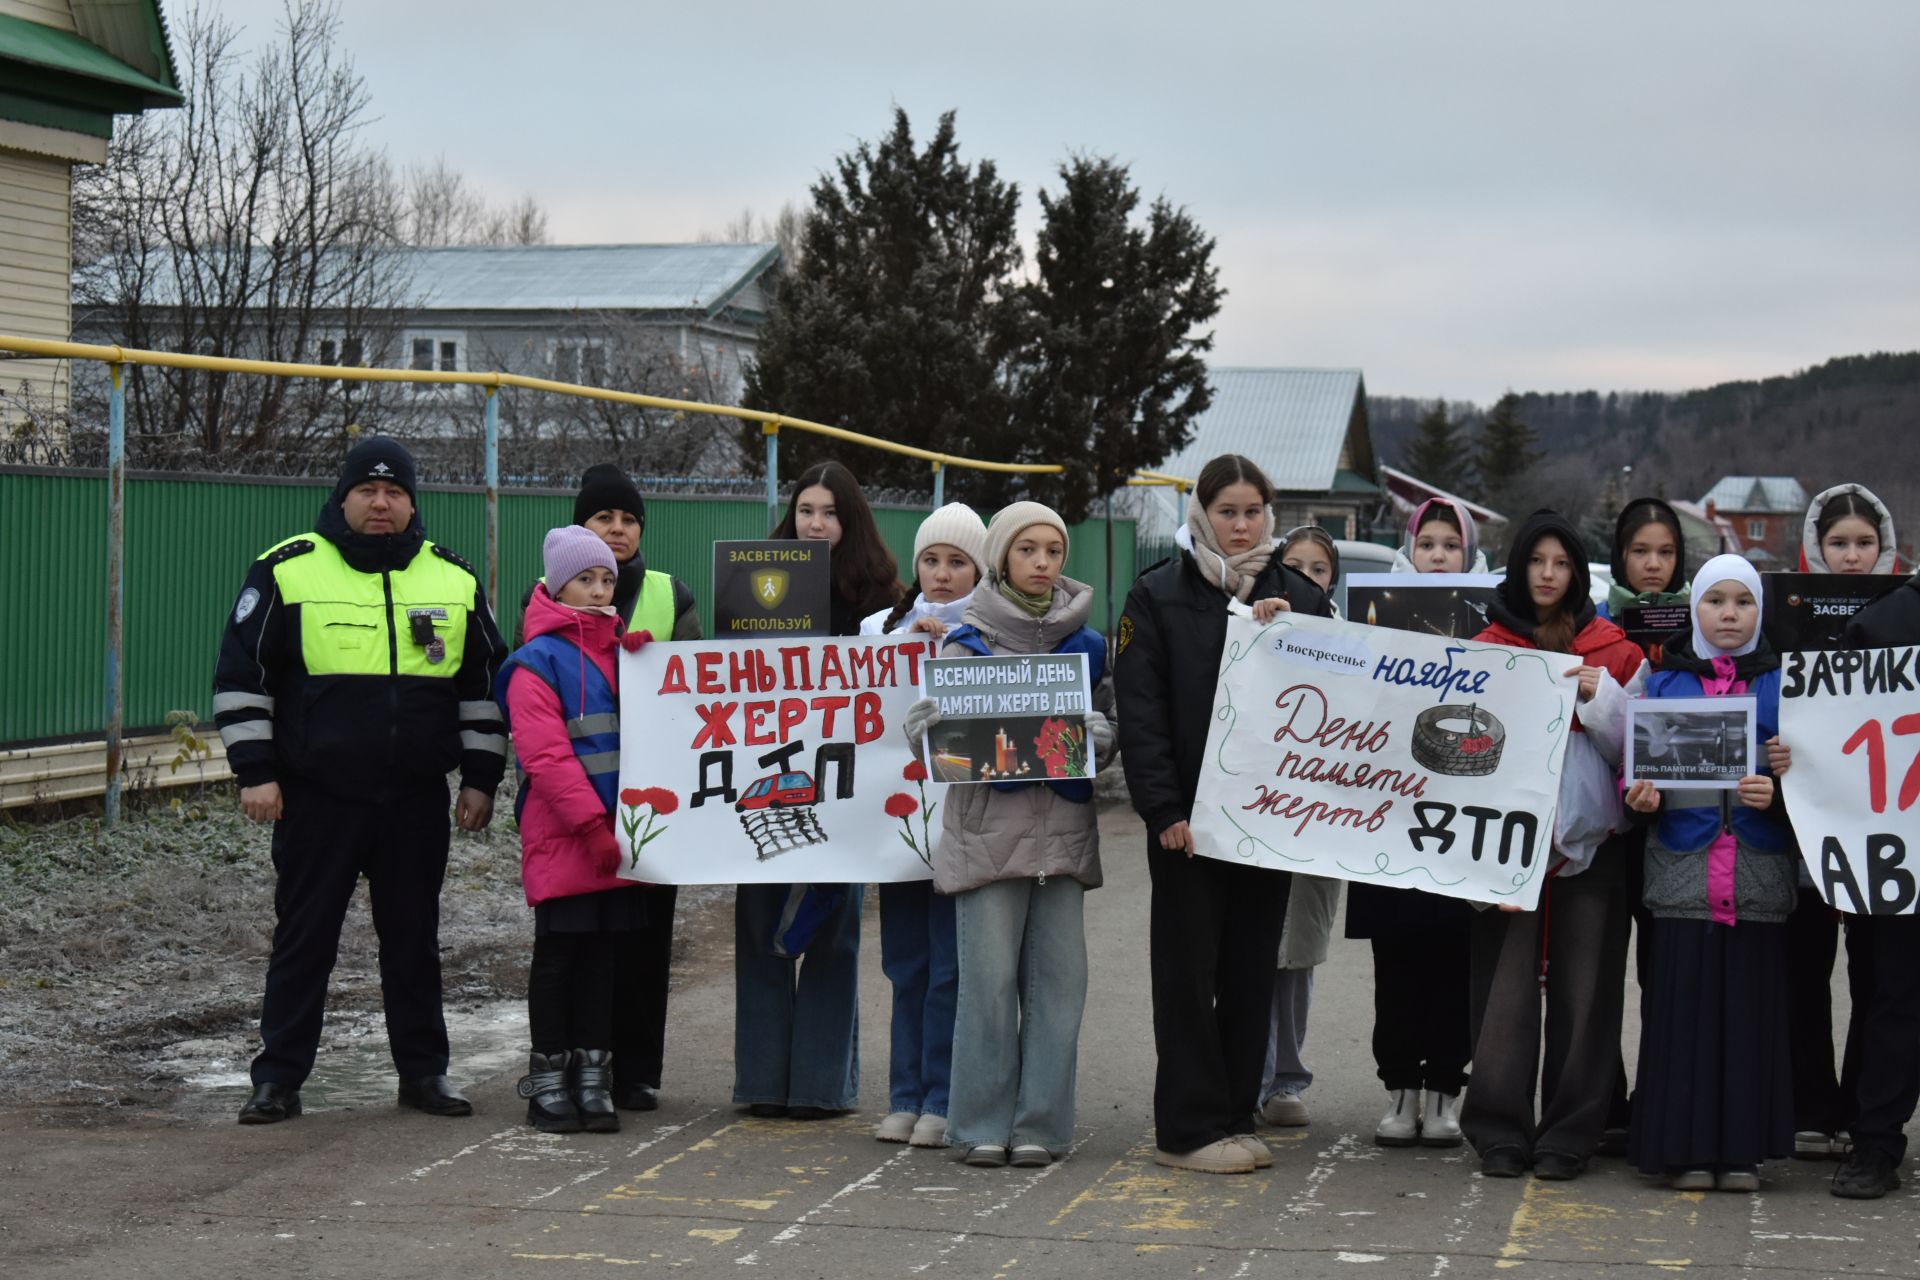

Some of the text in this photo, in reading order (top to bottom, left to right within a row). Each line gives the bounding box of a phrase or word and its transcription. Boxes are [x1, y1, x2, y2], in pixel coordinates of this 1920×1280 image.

[729, 549, 812, 562] ЗАСВЕТИСЬ!
[731, 614, 812, 630] ИСПОЛЬЗУЙ
[934, 658, 1076, 687] ВСЕМИРНЫЙ ДЕНЬ
[1274, 639, 1491, 702] 3 воскресенье ноября
[1781, 648, 1920, 698] ЗАФИК
[691, 691, 885, 749] ЖЕРТВ
[998, 692, 1050, 714] ЖЕРТВ
[1054, 691, 1085, 715] ДТП
[1274, 684, 1391, 753] День
[690, 740, 856, 808] ДТП
[1276, 751, 1428, 798] памяти
[1635, 764, 1747, 774] ДЕНЬ ПАМЯТИ ЖЕРТВ ДТП
[1242, 785, 1538, 868] жертв ДТП
[1821, 833, 1920, 915] АВ
